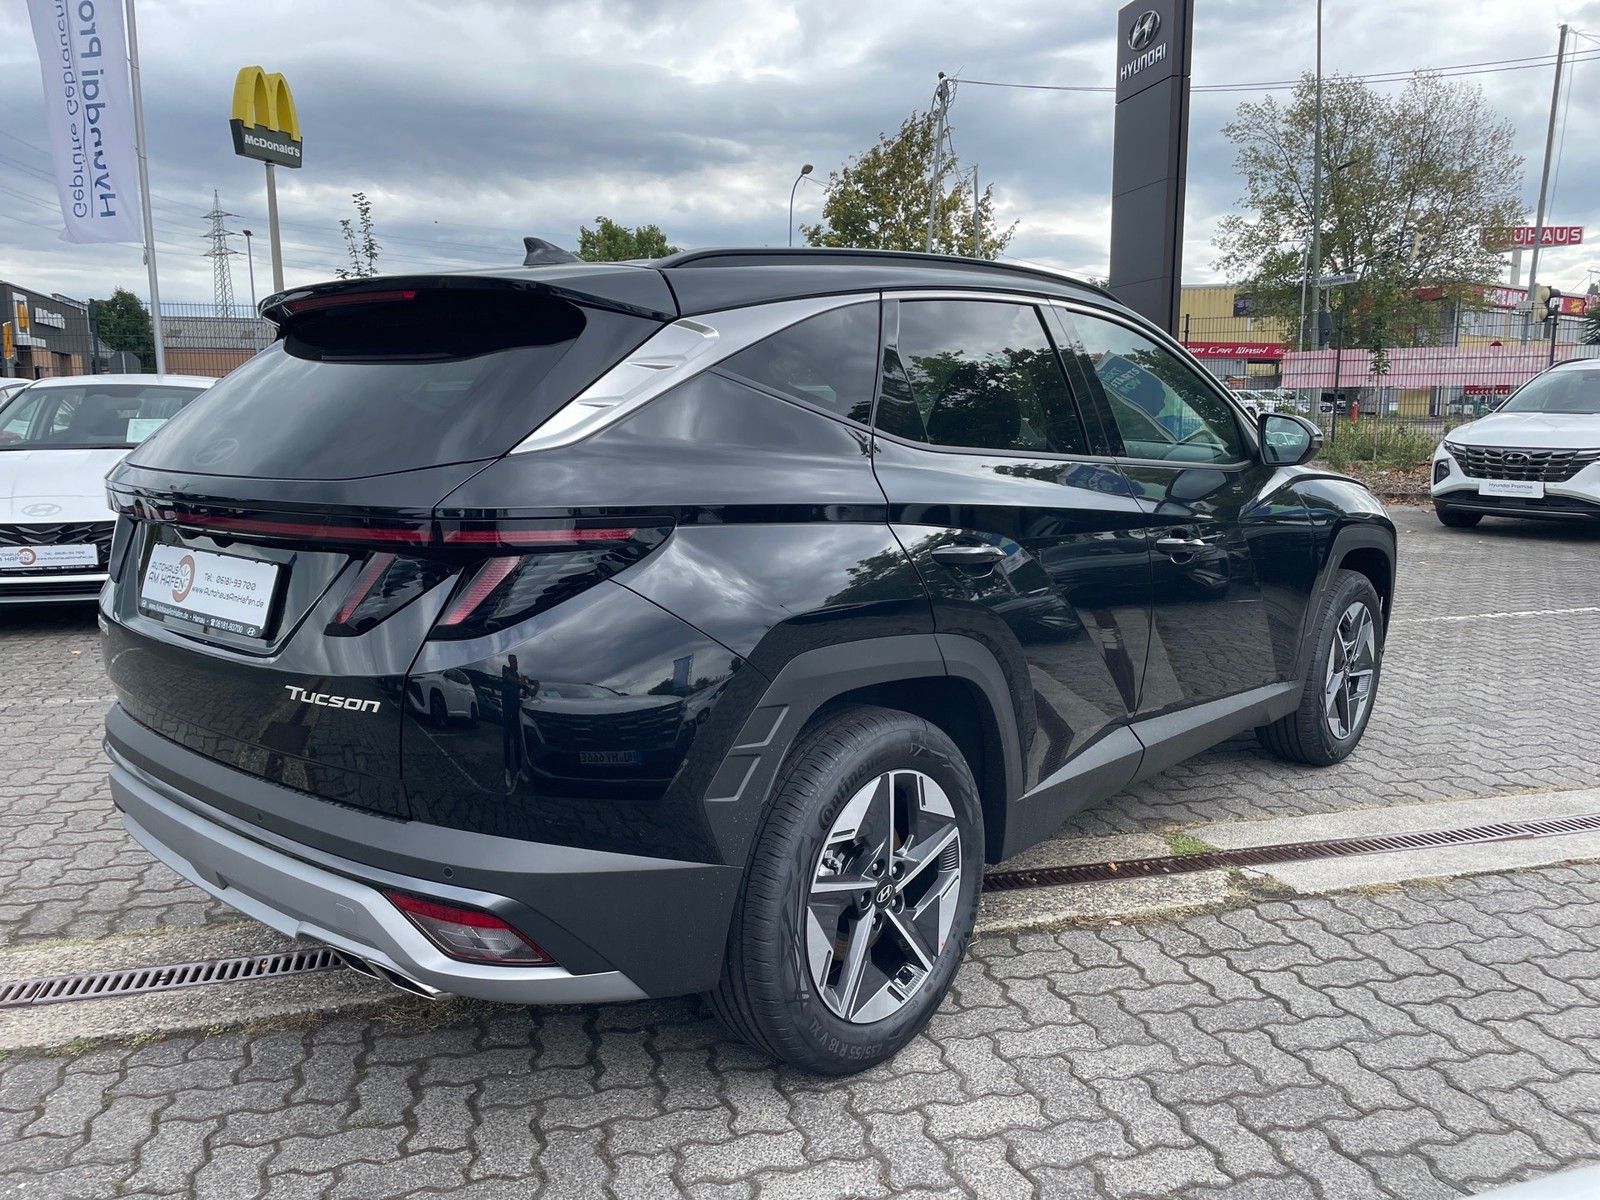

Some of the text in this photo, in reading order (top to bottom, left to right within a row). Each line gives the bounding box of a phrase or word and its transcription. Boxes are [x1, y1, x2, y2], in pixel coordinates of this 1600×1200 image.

[1120, 43, 1167, 81] HYUNDAI
[244, 134, 300, 157] McDonald's
[1485, 228, 1581, 242] UHAUS
[160, 573, 186, 589] HAFEN
